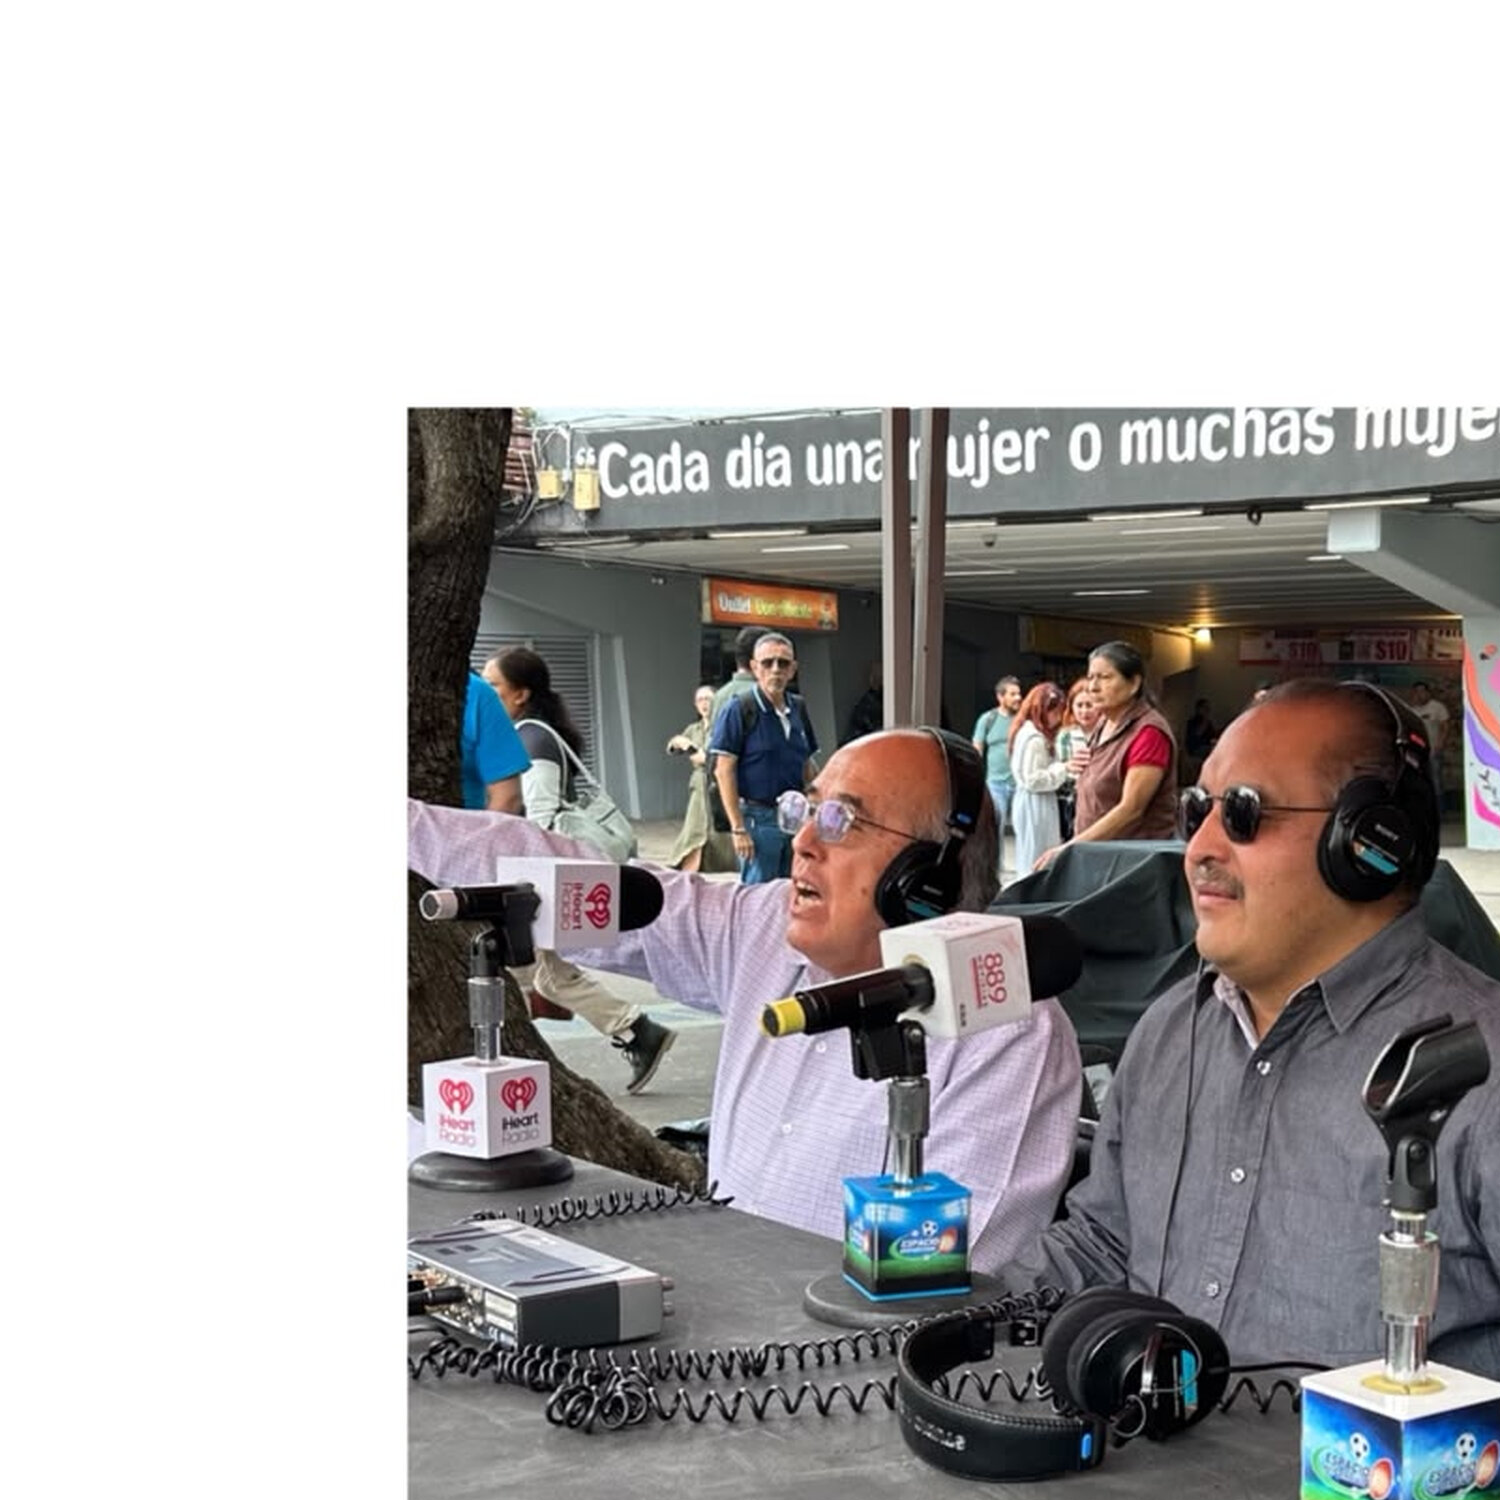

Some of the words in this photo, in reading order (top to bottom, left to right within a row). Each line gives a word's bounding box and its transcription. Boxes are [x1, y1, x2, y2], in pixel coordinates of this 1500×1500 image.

[725, 432, 792, 489] día
[806, 439, 884, 486] una
[908, 417, 1050, 488] ujer
[1068, 422, 1103, 472] o
[1119, 407, 1336, 465] muchas
[502, 1112, 539, 1131] iHeart
